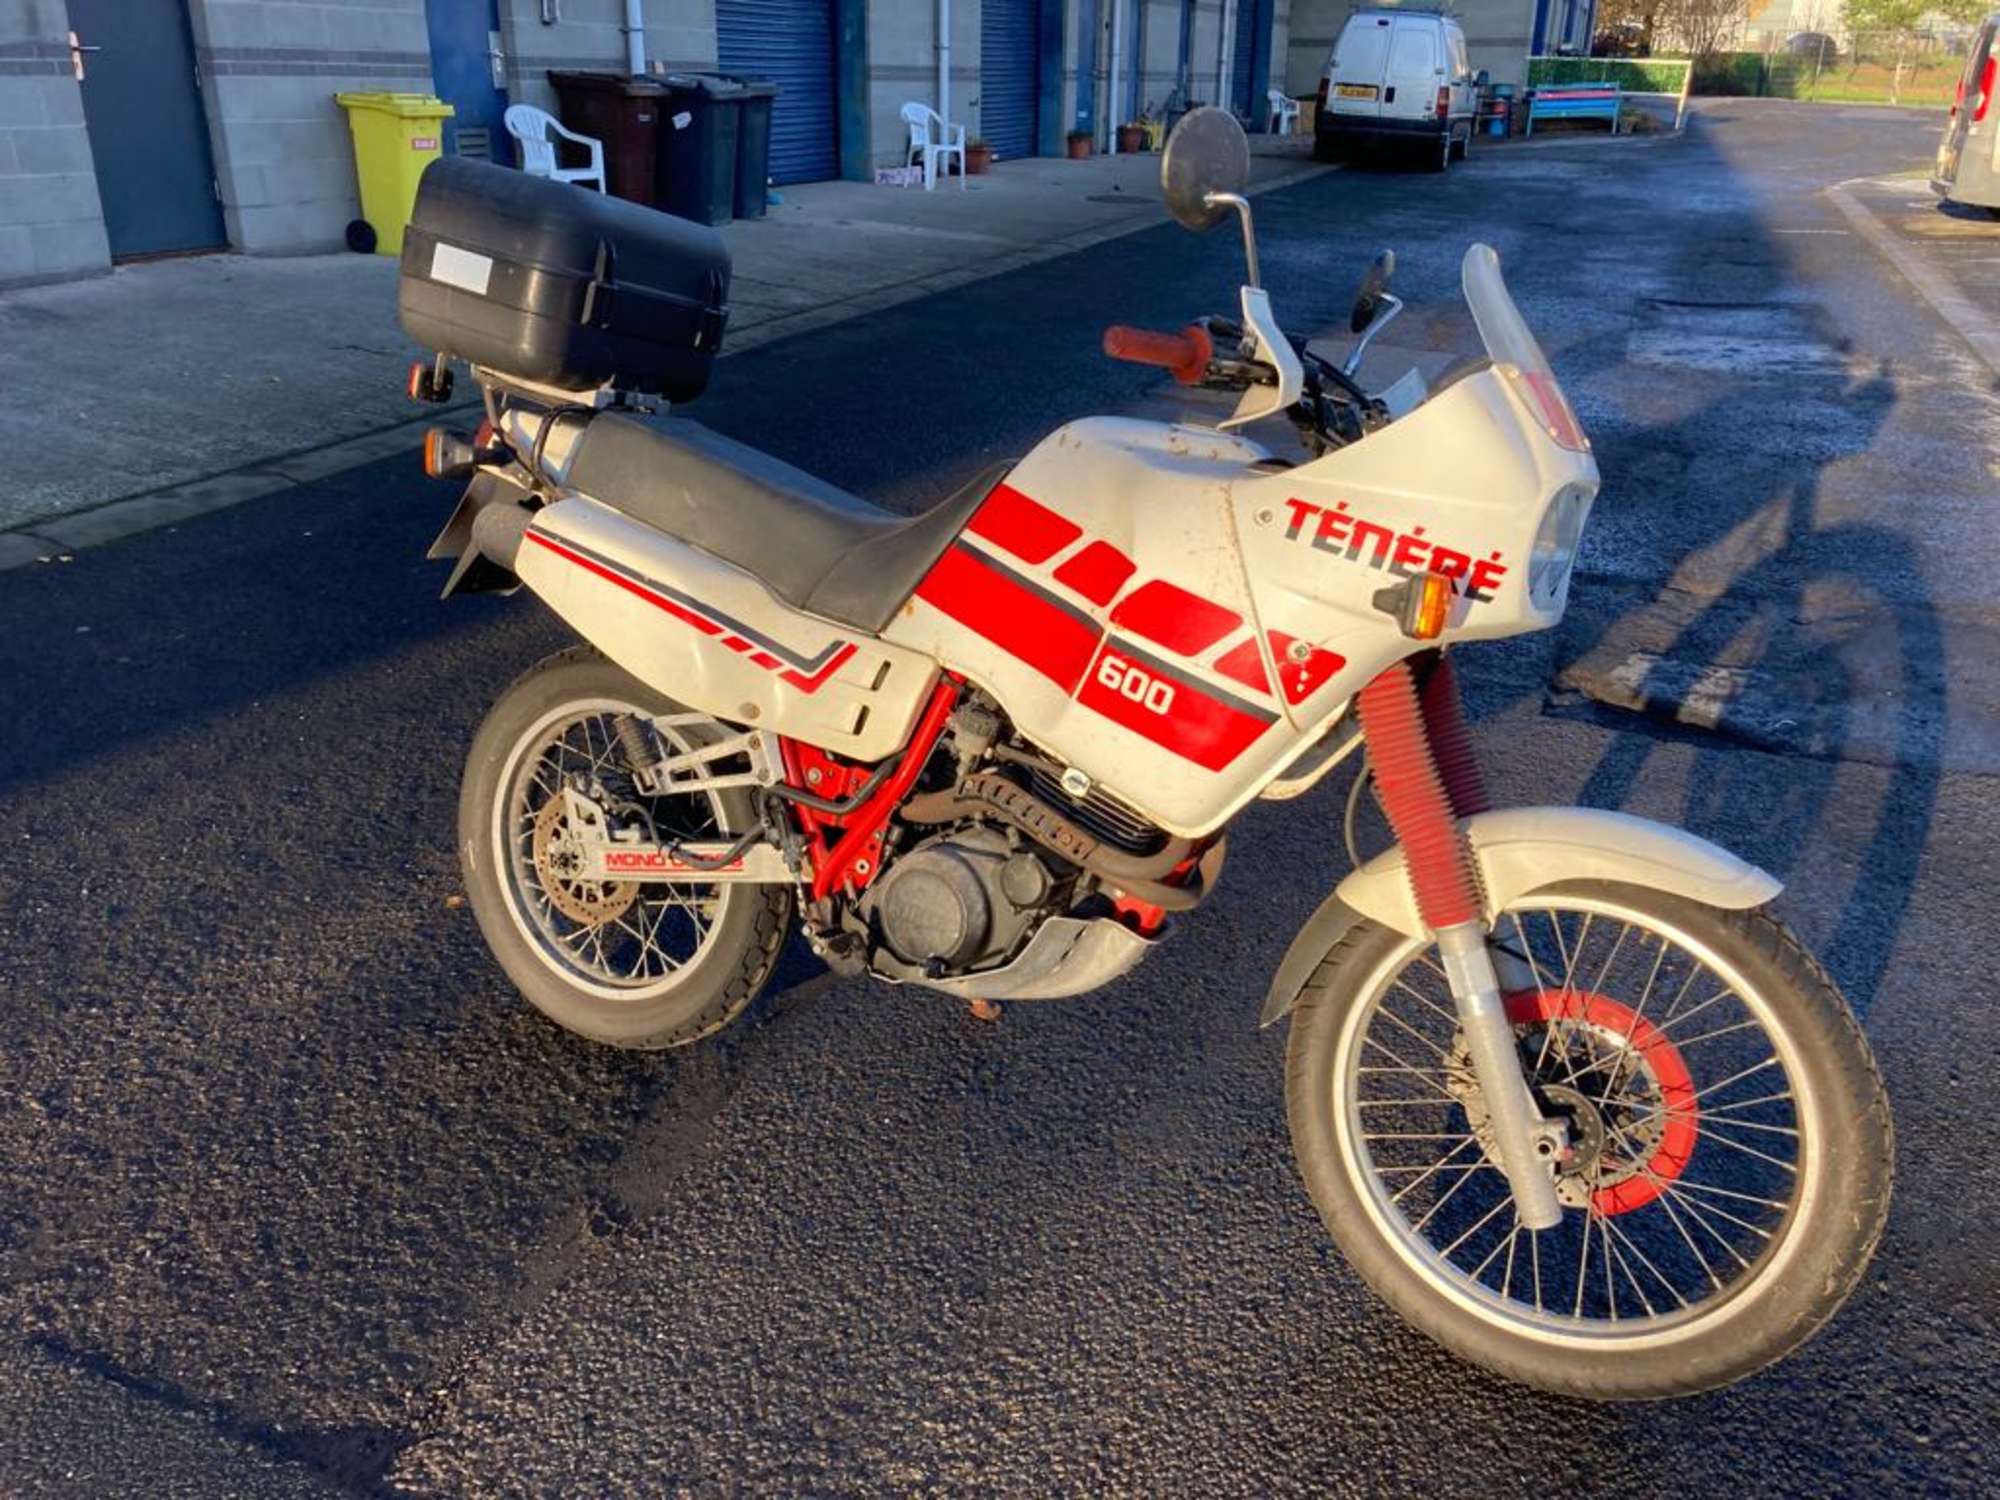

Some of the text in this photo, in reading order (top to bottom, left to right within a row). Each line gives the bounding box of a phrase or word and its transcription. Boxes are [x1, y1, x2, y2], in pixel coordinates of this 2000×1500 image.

[1285, 498, 1508, 604] TÉNÉRÉ
[1097, 655, 1176, 715] 600
[605, 853, 666, 866] MONO
